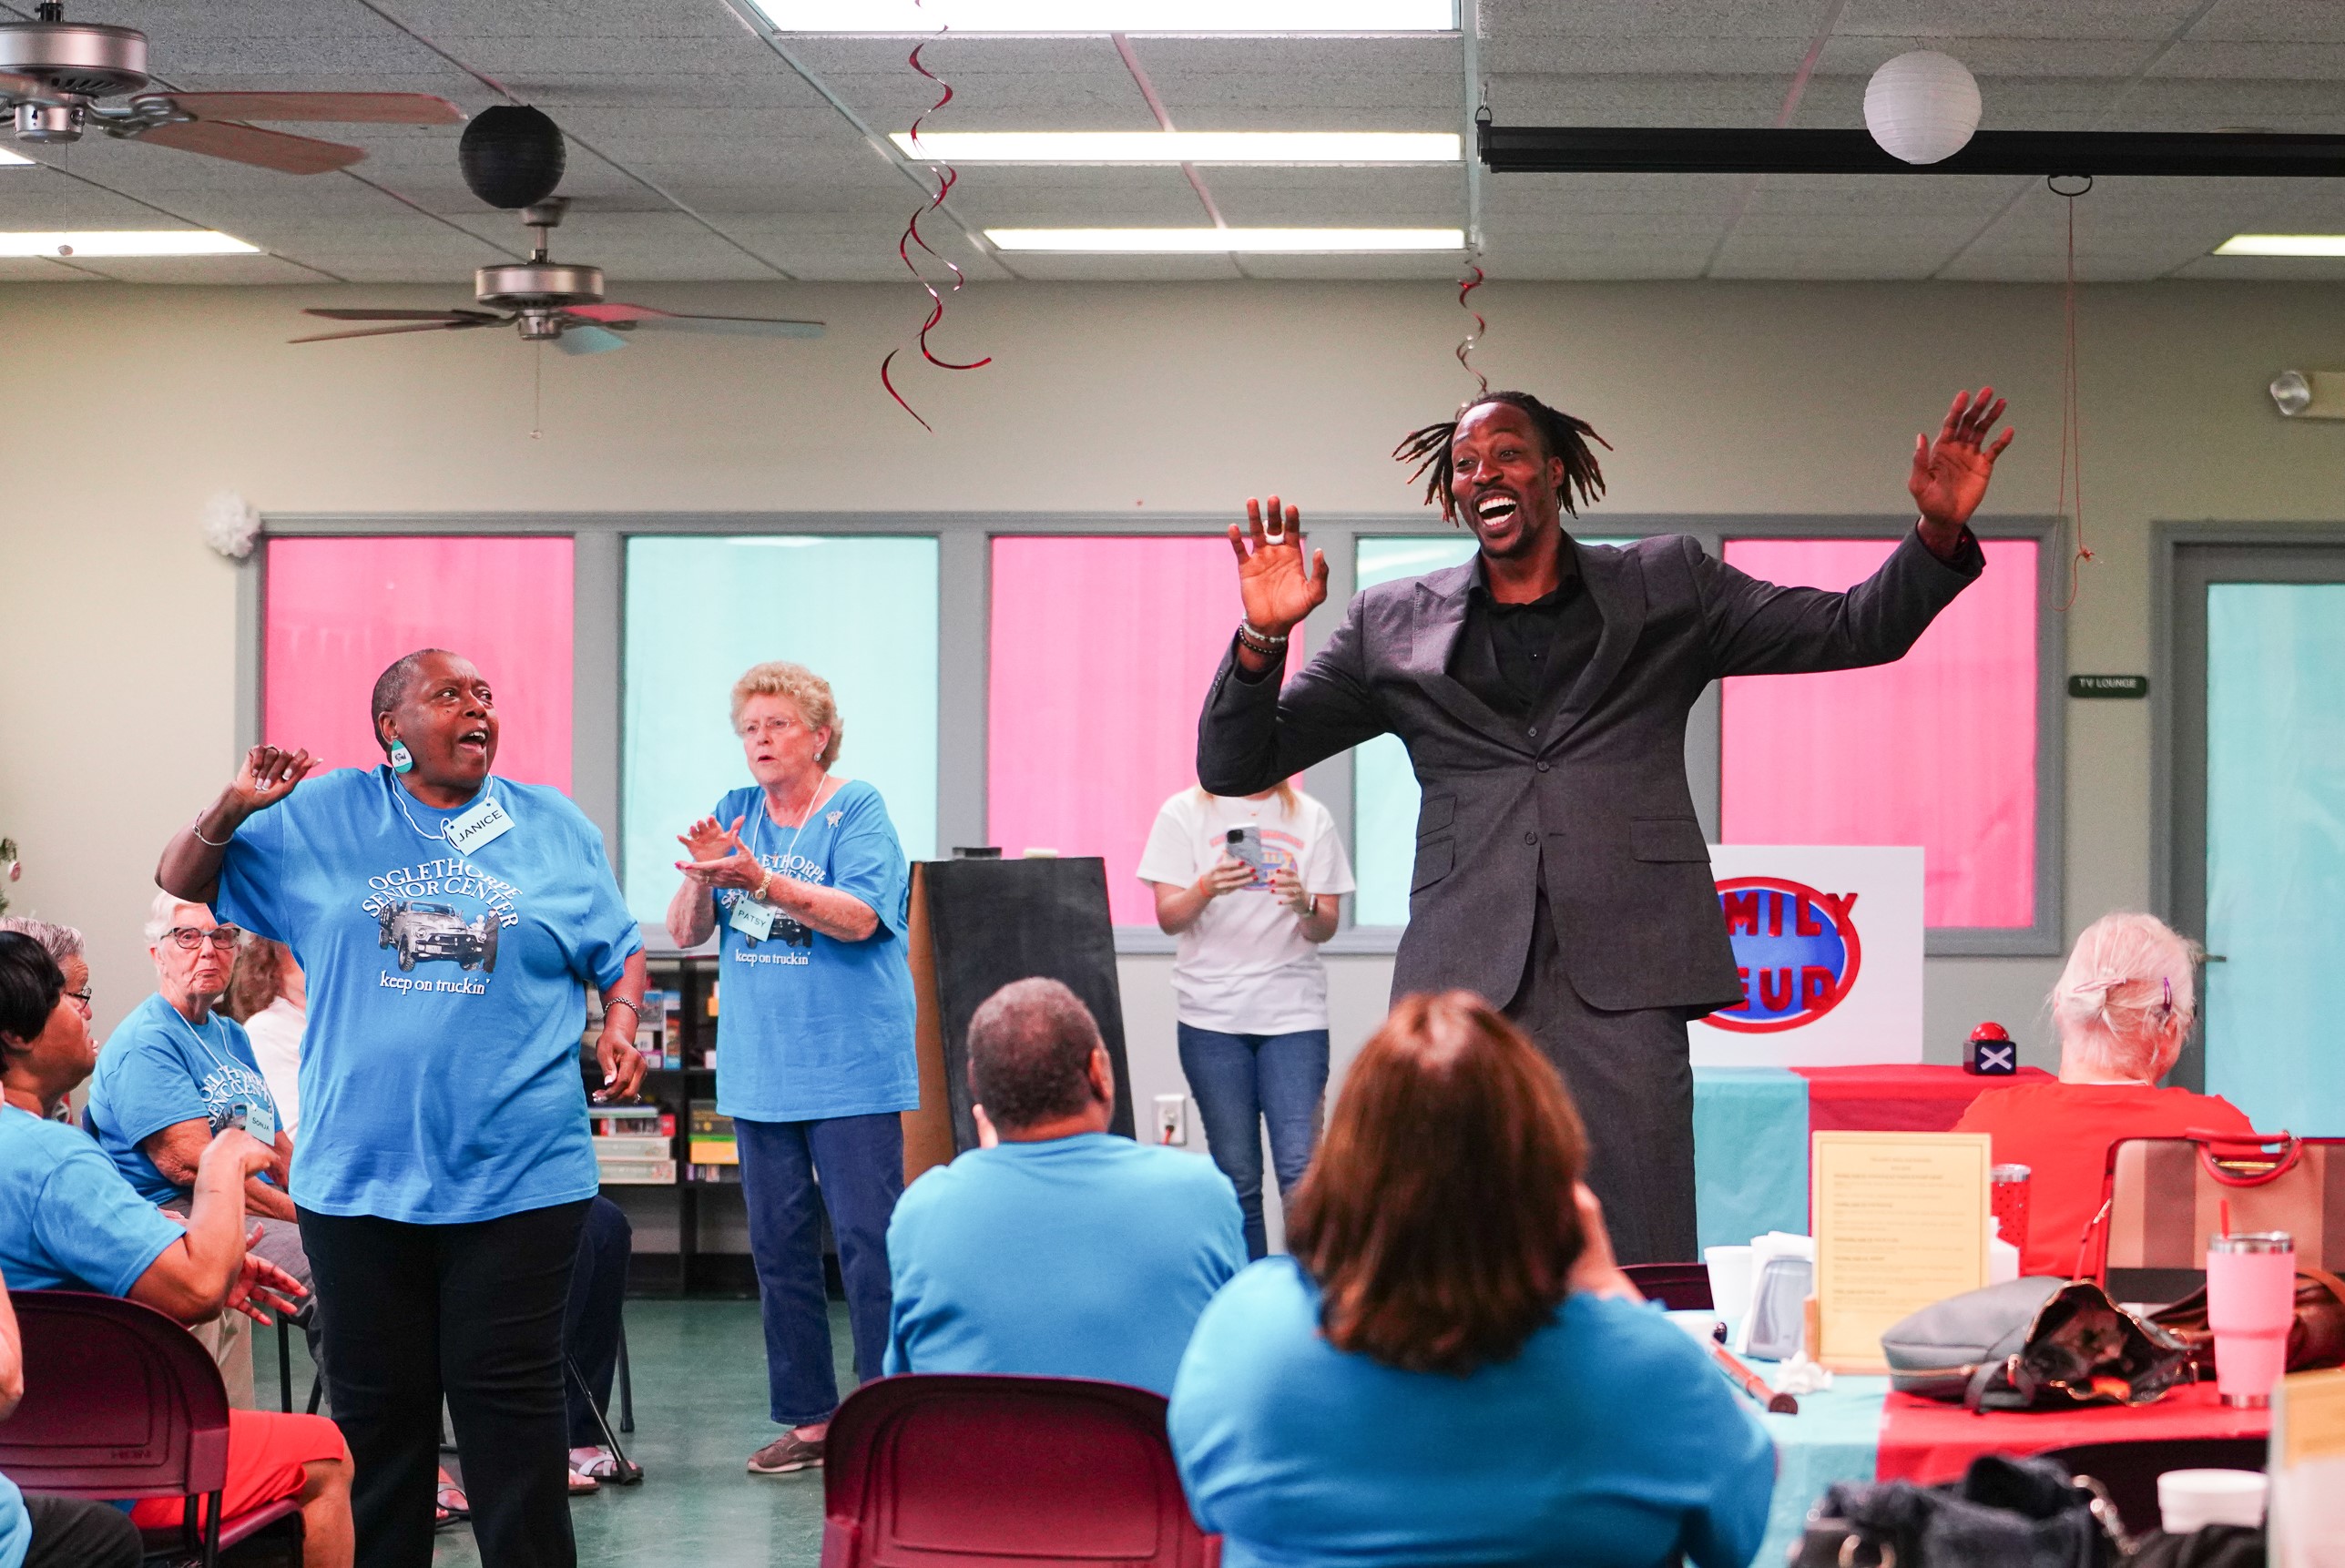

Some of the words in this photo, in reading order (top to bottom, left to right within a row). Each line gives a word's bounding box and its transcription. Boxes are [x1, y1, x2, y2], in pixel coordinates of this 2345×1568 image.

[2079, 677, 2094, 688] TV
[2095, 677, 2137, 688] LOUNGE
[459, 809, 503, 842] JANICE
[368, 858, 523, 900] OGLETHORPE
[362, 881, 440, 919] SENIOR
[444, 877, 520, 930] CENTER
[1724, 891, 1859, 936] MILY
[738, 910, 767, 928] PATSY
[735, 949, 758, 967] keep
[759, 954, 771, 963] on
[772, 952, 811, 965] truckin'
[380, 970, 413, 995] keep
[414, 979, 433, 992] on
[436, 977, 492, 996] truckin'
[252, 1117, 270, 1131] SONJA
